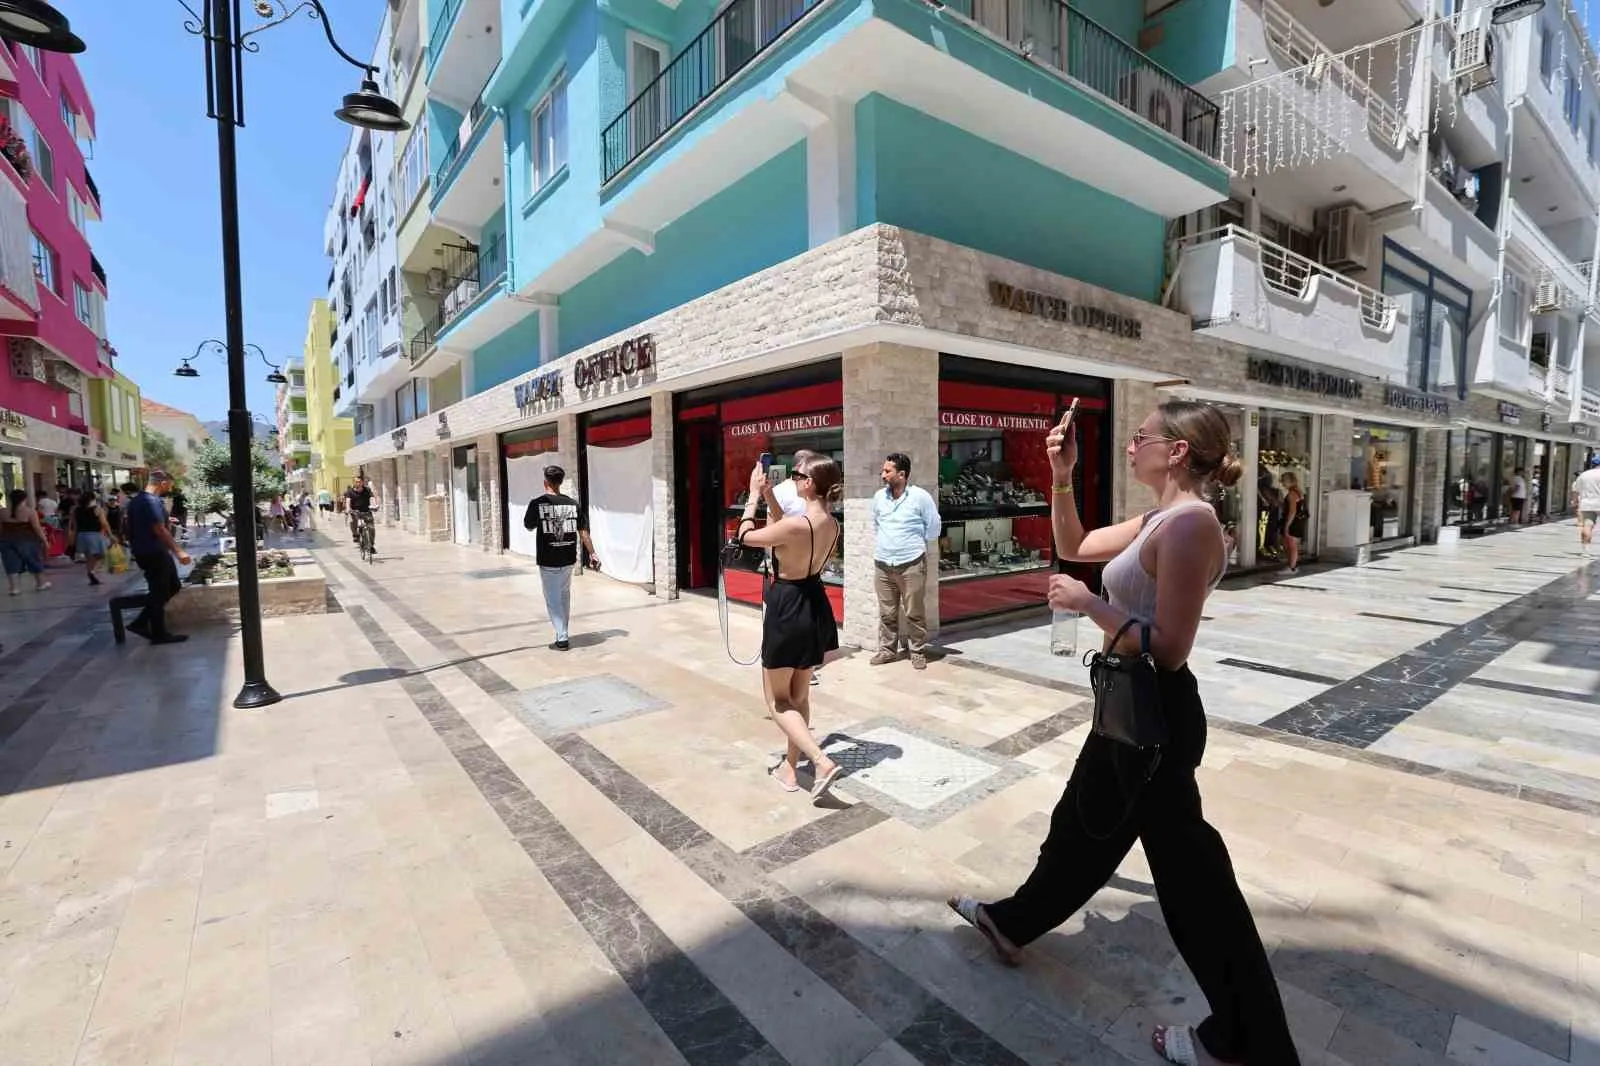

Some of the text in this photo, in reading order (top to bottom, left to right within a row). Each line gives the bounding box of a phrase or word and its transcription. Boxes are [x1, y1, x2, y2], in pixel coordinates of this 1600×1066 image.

[574, 333, 653, 389] OFFICE
[731, 413, 831, 437] CLOSE TO AUTHENTIC
[942, 412, 1049, 430] CLOSE TO AUTHENTIC
